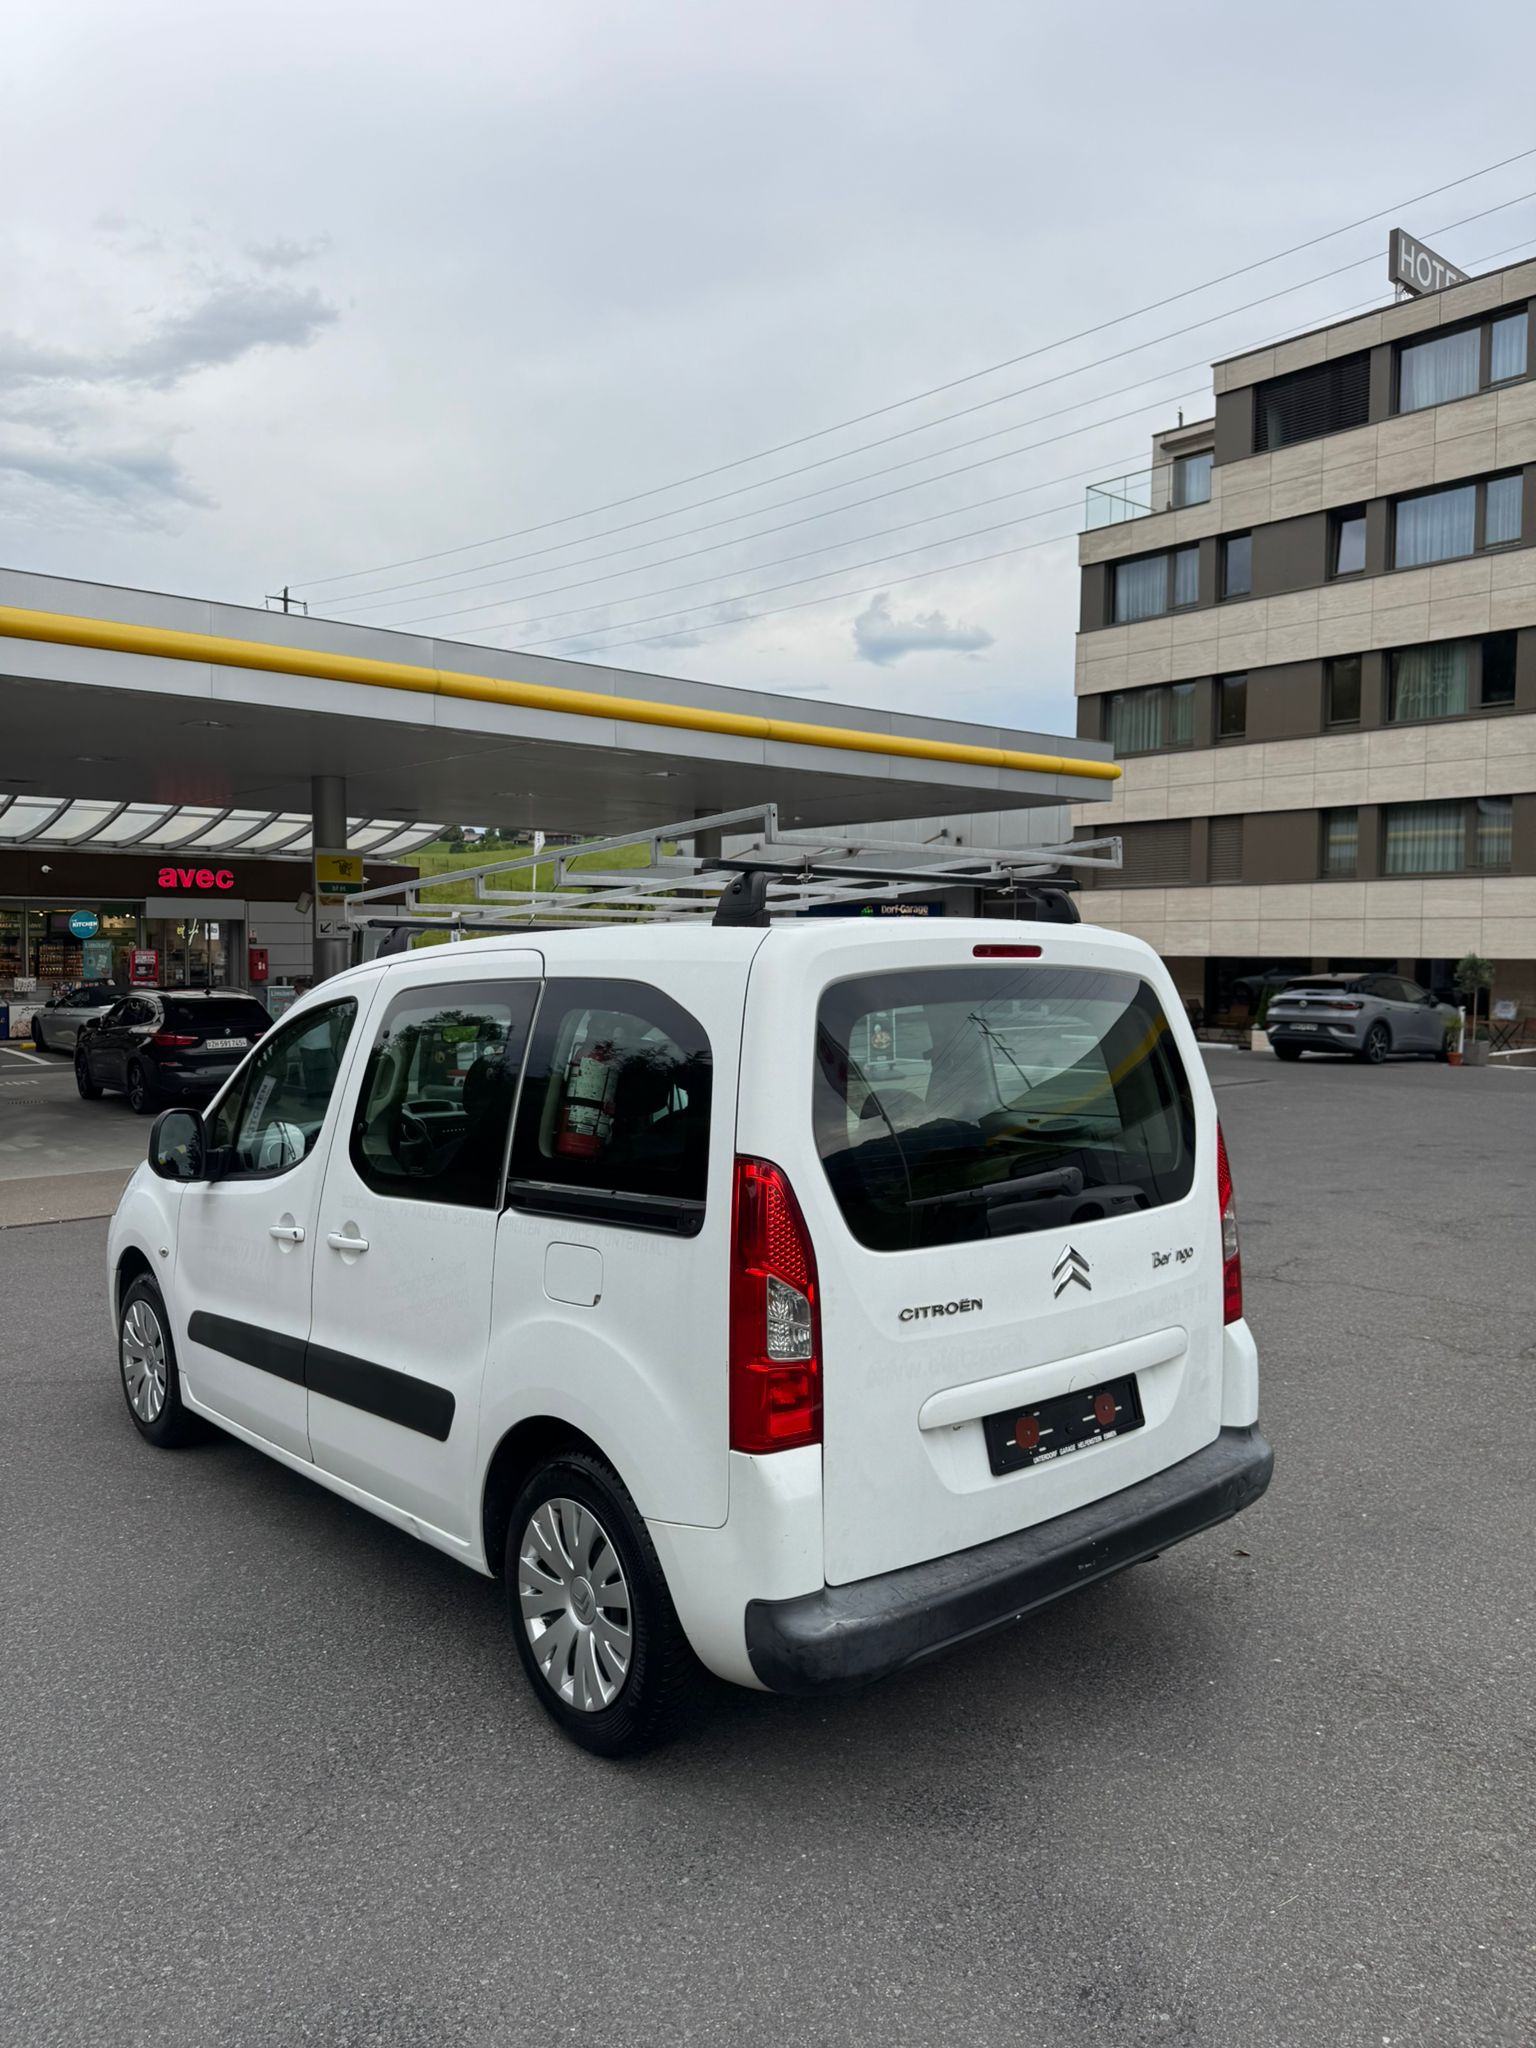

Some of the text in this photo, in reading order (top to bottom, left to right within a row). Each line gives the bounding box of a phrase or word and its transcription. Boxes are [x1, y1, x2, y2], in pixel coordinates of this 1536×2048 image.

[1401, 238, 1463, 291] HOT
[158, 867, 234, 889] avec
[881, 905, 929, 915] Dorf-Garage
[72, 920, 98, 928] KITCHEN
[1151, 1247, 1194, 1269] Berngo
[897, 1298, 984, 1322] CITROËN
[1059, 1444, 1076, 1456] GARAGE
